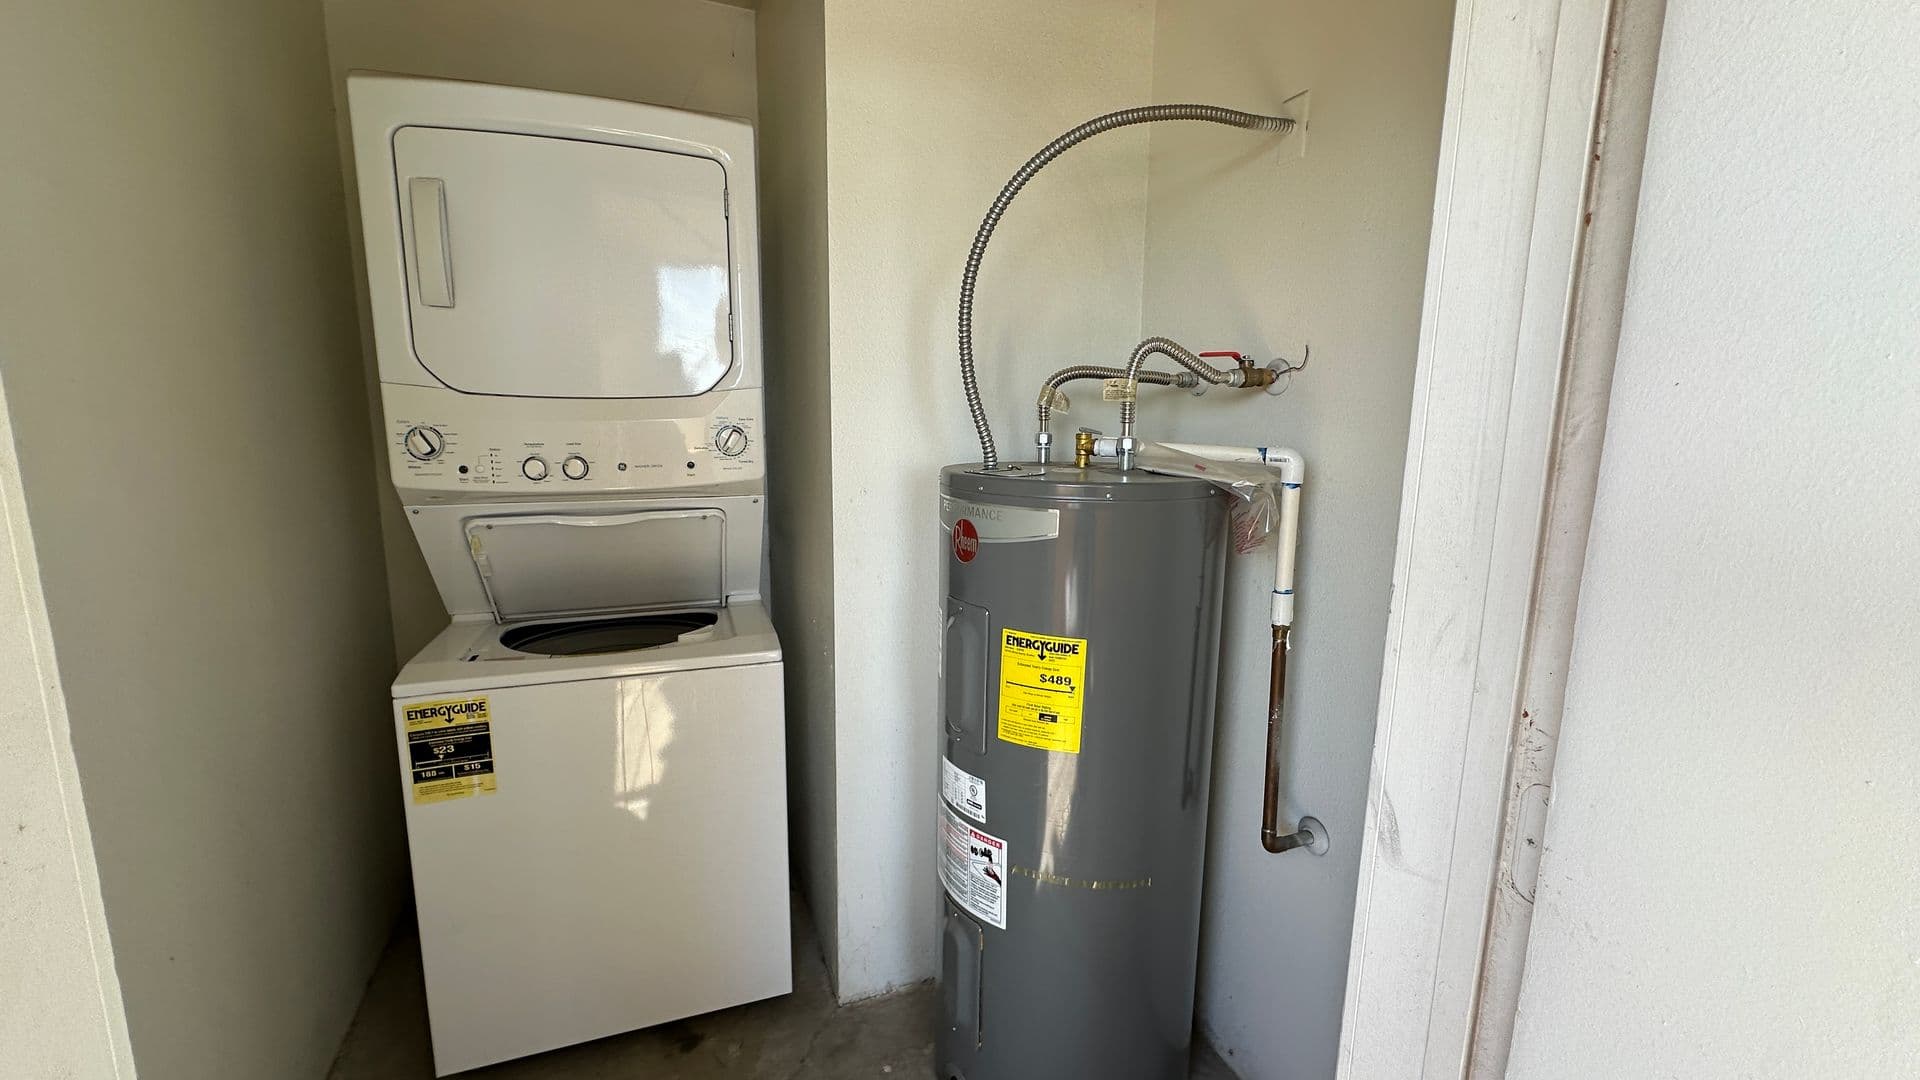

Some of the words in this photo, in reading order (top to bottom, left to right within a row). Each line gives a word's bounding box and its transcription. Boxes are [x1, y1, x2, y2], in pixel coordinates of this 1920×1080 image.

[955, 519, 978, 556] Rheem
[1006, 634, 1079, 656] ENERGYGUIDE
[1040, 673, 1072, 687] $489
[407, 701, 486, 721] ENERGYGUIDE
[433, 745, 455, 754] $23
